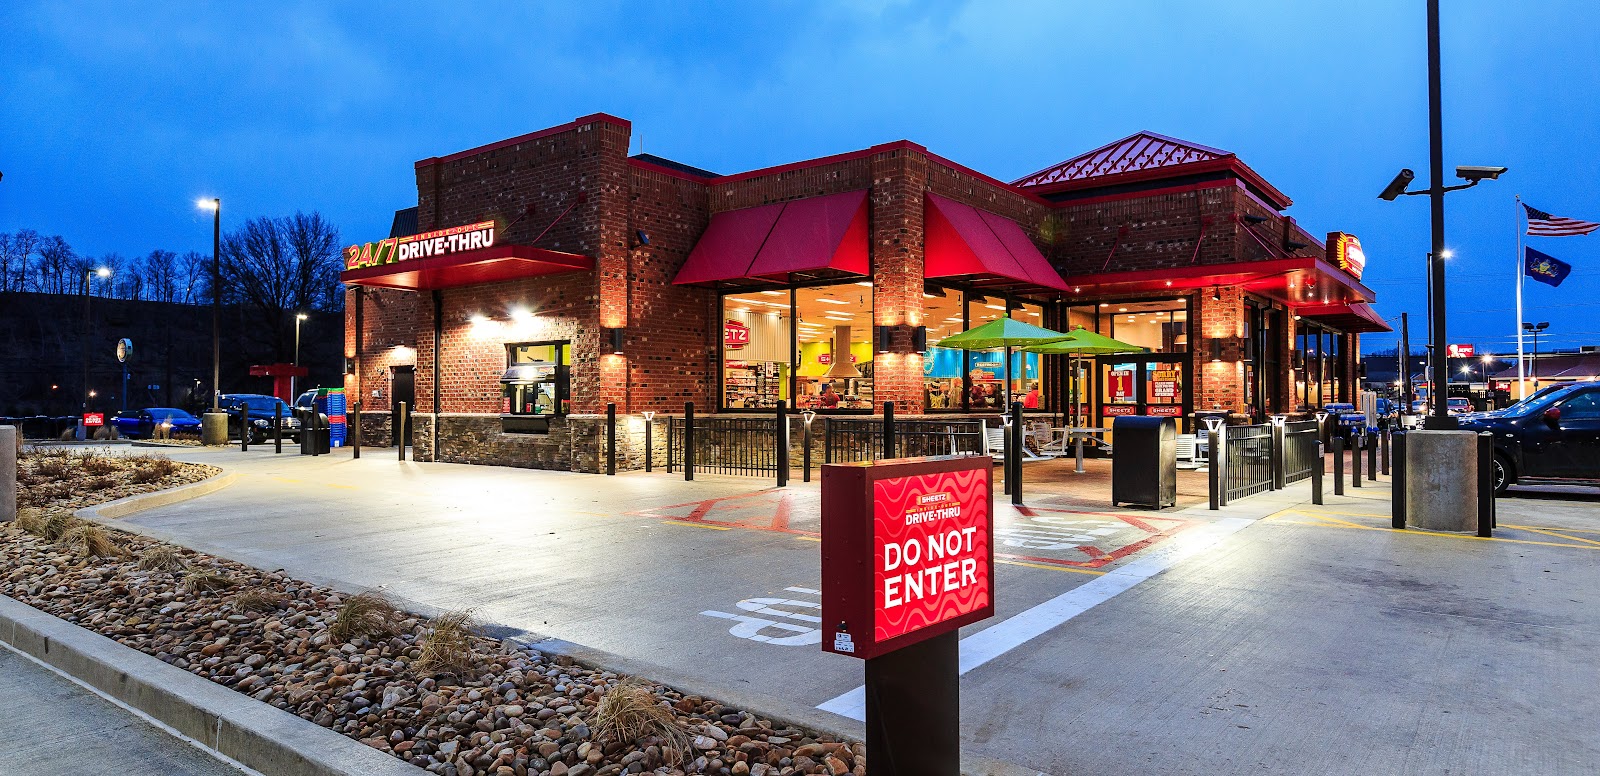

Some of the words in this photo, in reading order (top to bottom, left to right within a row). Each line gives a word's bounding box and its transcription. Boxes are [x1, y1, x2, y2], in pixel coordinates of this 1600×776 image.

[347, 237, 398, 271] 24/7
[398, 228, 494, 261] DRIVE-THRU
[1117, 375, 1123, 391] 1
[1153, 370, 1176, 378] SORRY
[922, 494, 946, 503] SHEETZ
[905, 506, 960, 526] DRIVE-THRU
[884, 538, 921, 572] DO
[928, 526, 977, 562] NOT
[884, 557, 978, 609] ENTER
